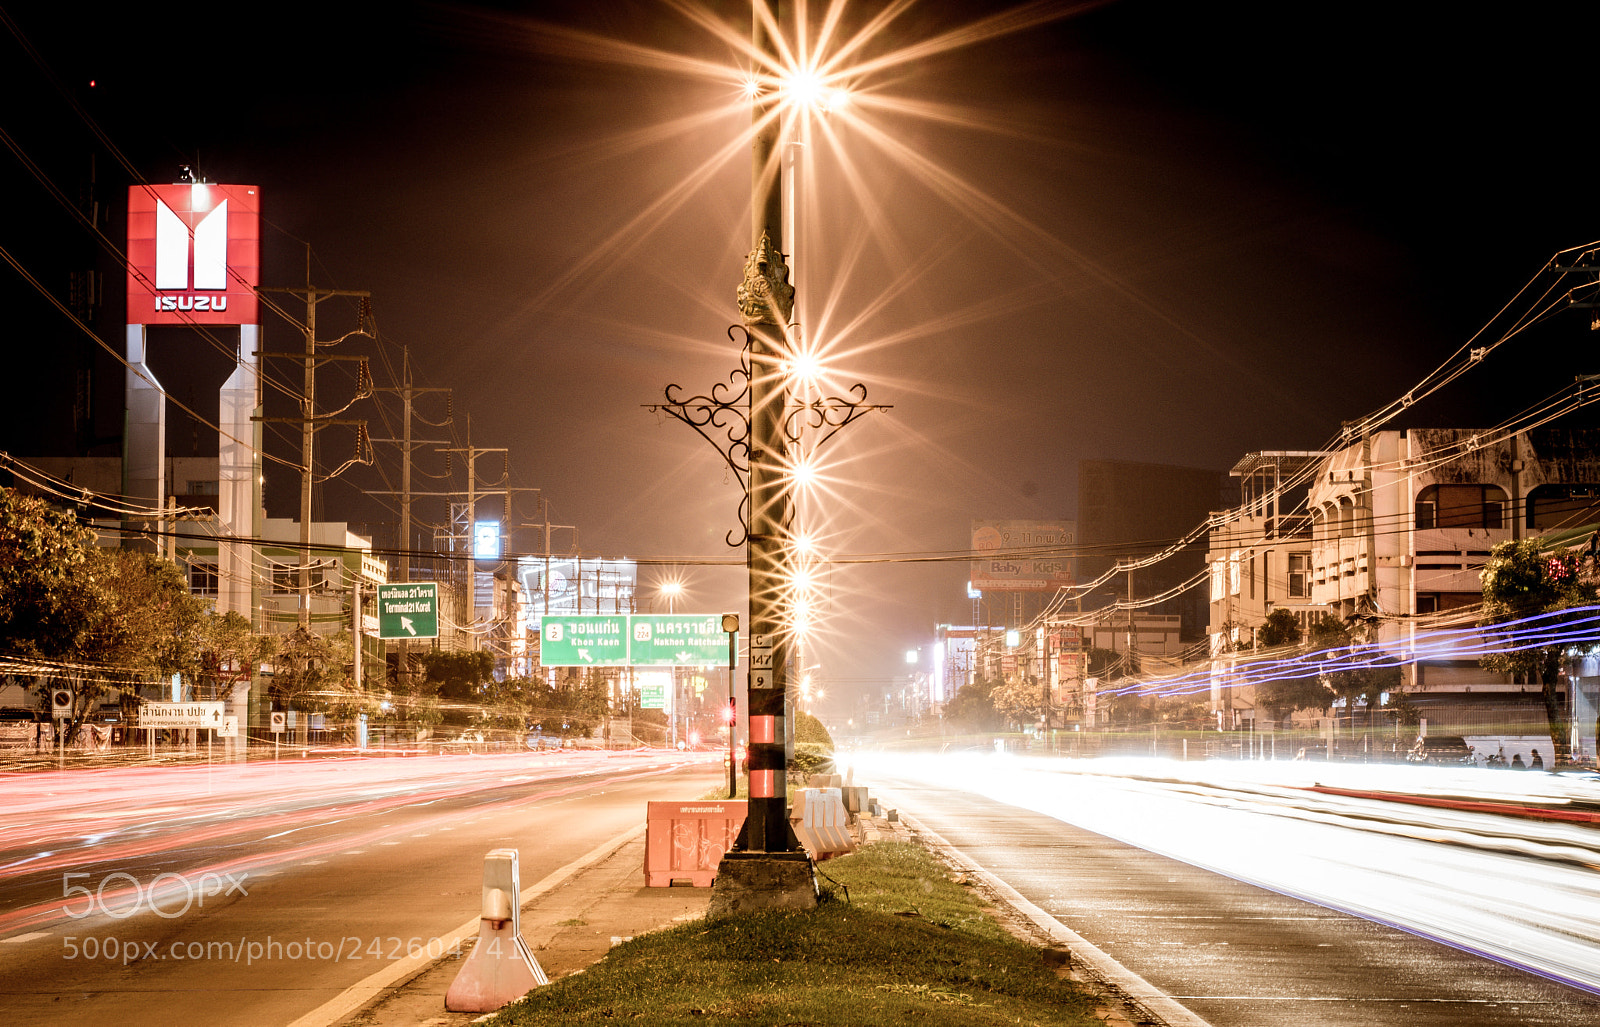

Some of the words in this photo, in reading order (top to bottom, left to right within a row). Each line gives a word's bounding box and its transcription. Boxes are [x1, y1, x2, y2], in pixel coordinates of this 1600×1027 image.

[155, 295, 227, 312] ISUZU
[1002, 532, 1011, 543] 9
[1022, 532, 1031, 543] 11
[1060, 533, 1074, 544] 61
[991, 561, 1022, 575] Baby
[1033, 561, 1062, 573] Kids
[409, 588, 417, 598] 21
[417, 586, 434, 598] โคราช
[415, 601, 431, 613] Korat
[570, 619, 620, 634] ขอนแก่น
[655, 618, 724, 634] นครราชสีม
[551, 631, 558, 639] 2
[636, 631, 650, 639] 224
[653, 637, 685, 646] Nakhon
[688, 635, 730, 647] Ratchasim
[756, 635, 763, 646] C
[571, 637, 594, 646] Khon
[597, 637, 620, 646] Kaen
[752, 654, 772, 665] 147
[757, 676, 764, 686] 9
[142, 705, 184, 717] สำนักงาน
